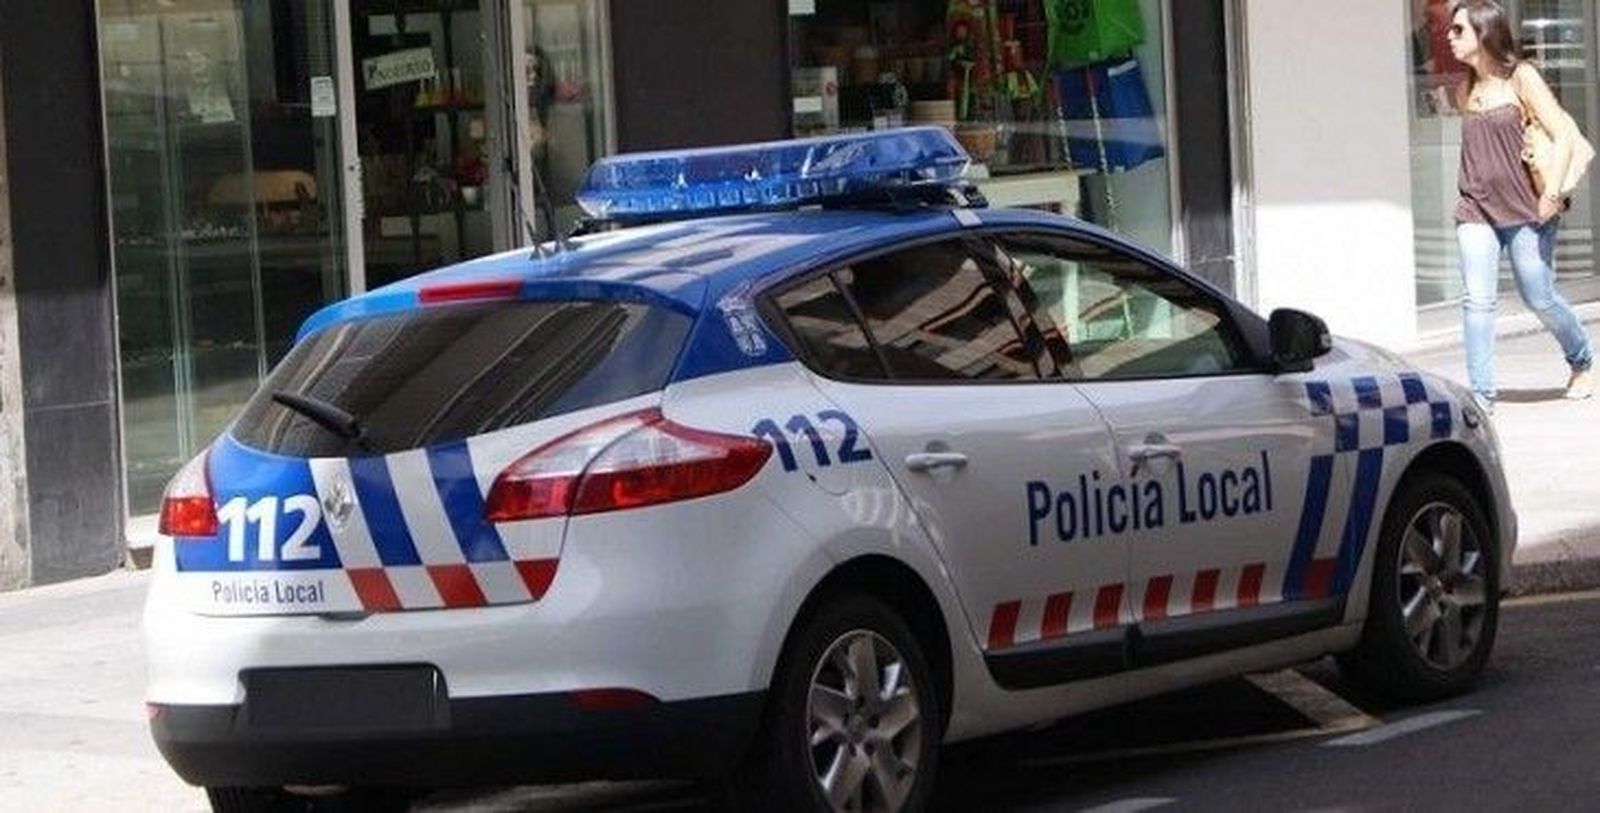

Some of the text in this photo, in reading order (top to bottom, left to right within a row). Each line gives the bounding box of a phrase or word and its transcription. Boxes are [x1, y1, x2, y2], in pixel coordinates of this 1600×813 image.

[752, 409, 873, 473] 112
[216, 494, 321, 562] 112
[1027, 450, 1272, 546] Policía Local
[275, 580, 325, 603] Local
